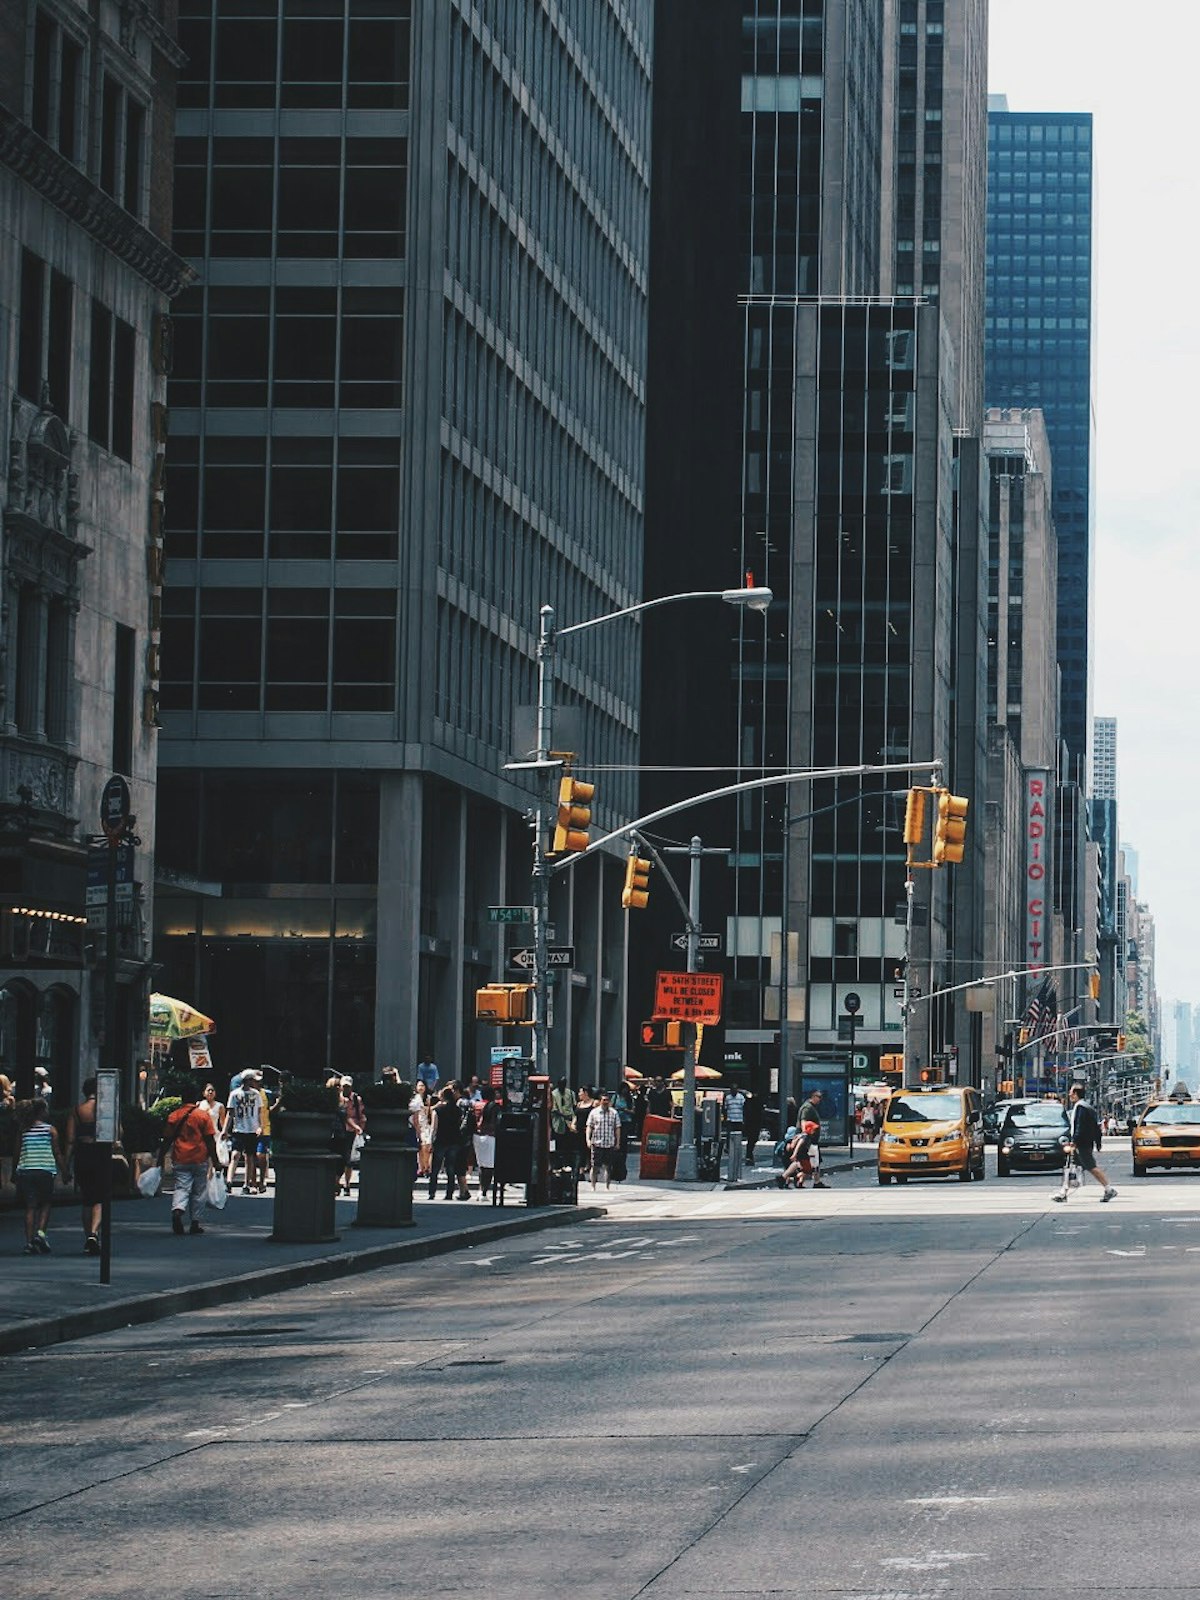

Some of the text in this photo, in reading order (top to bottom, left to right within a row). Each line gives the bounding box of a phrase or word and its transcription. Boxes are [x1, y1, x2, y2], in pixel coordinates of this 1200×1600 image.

[1028, 780, 1045, 980] RADIO CITY
[490, 909, 498, 921] W
[499, 909, 512, 921] 54
[692, 977, 719, 986] STREET
[663, 986, 716, 996] WILL BE CLOSED
[673, 997, 704, 1005] BETWEEN
[457, 1250, 662, 1267] NLY
